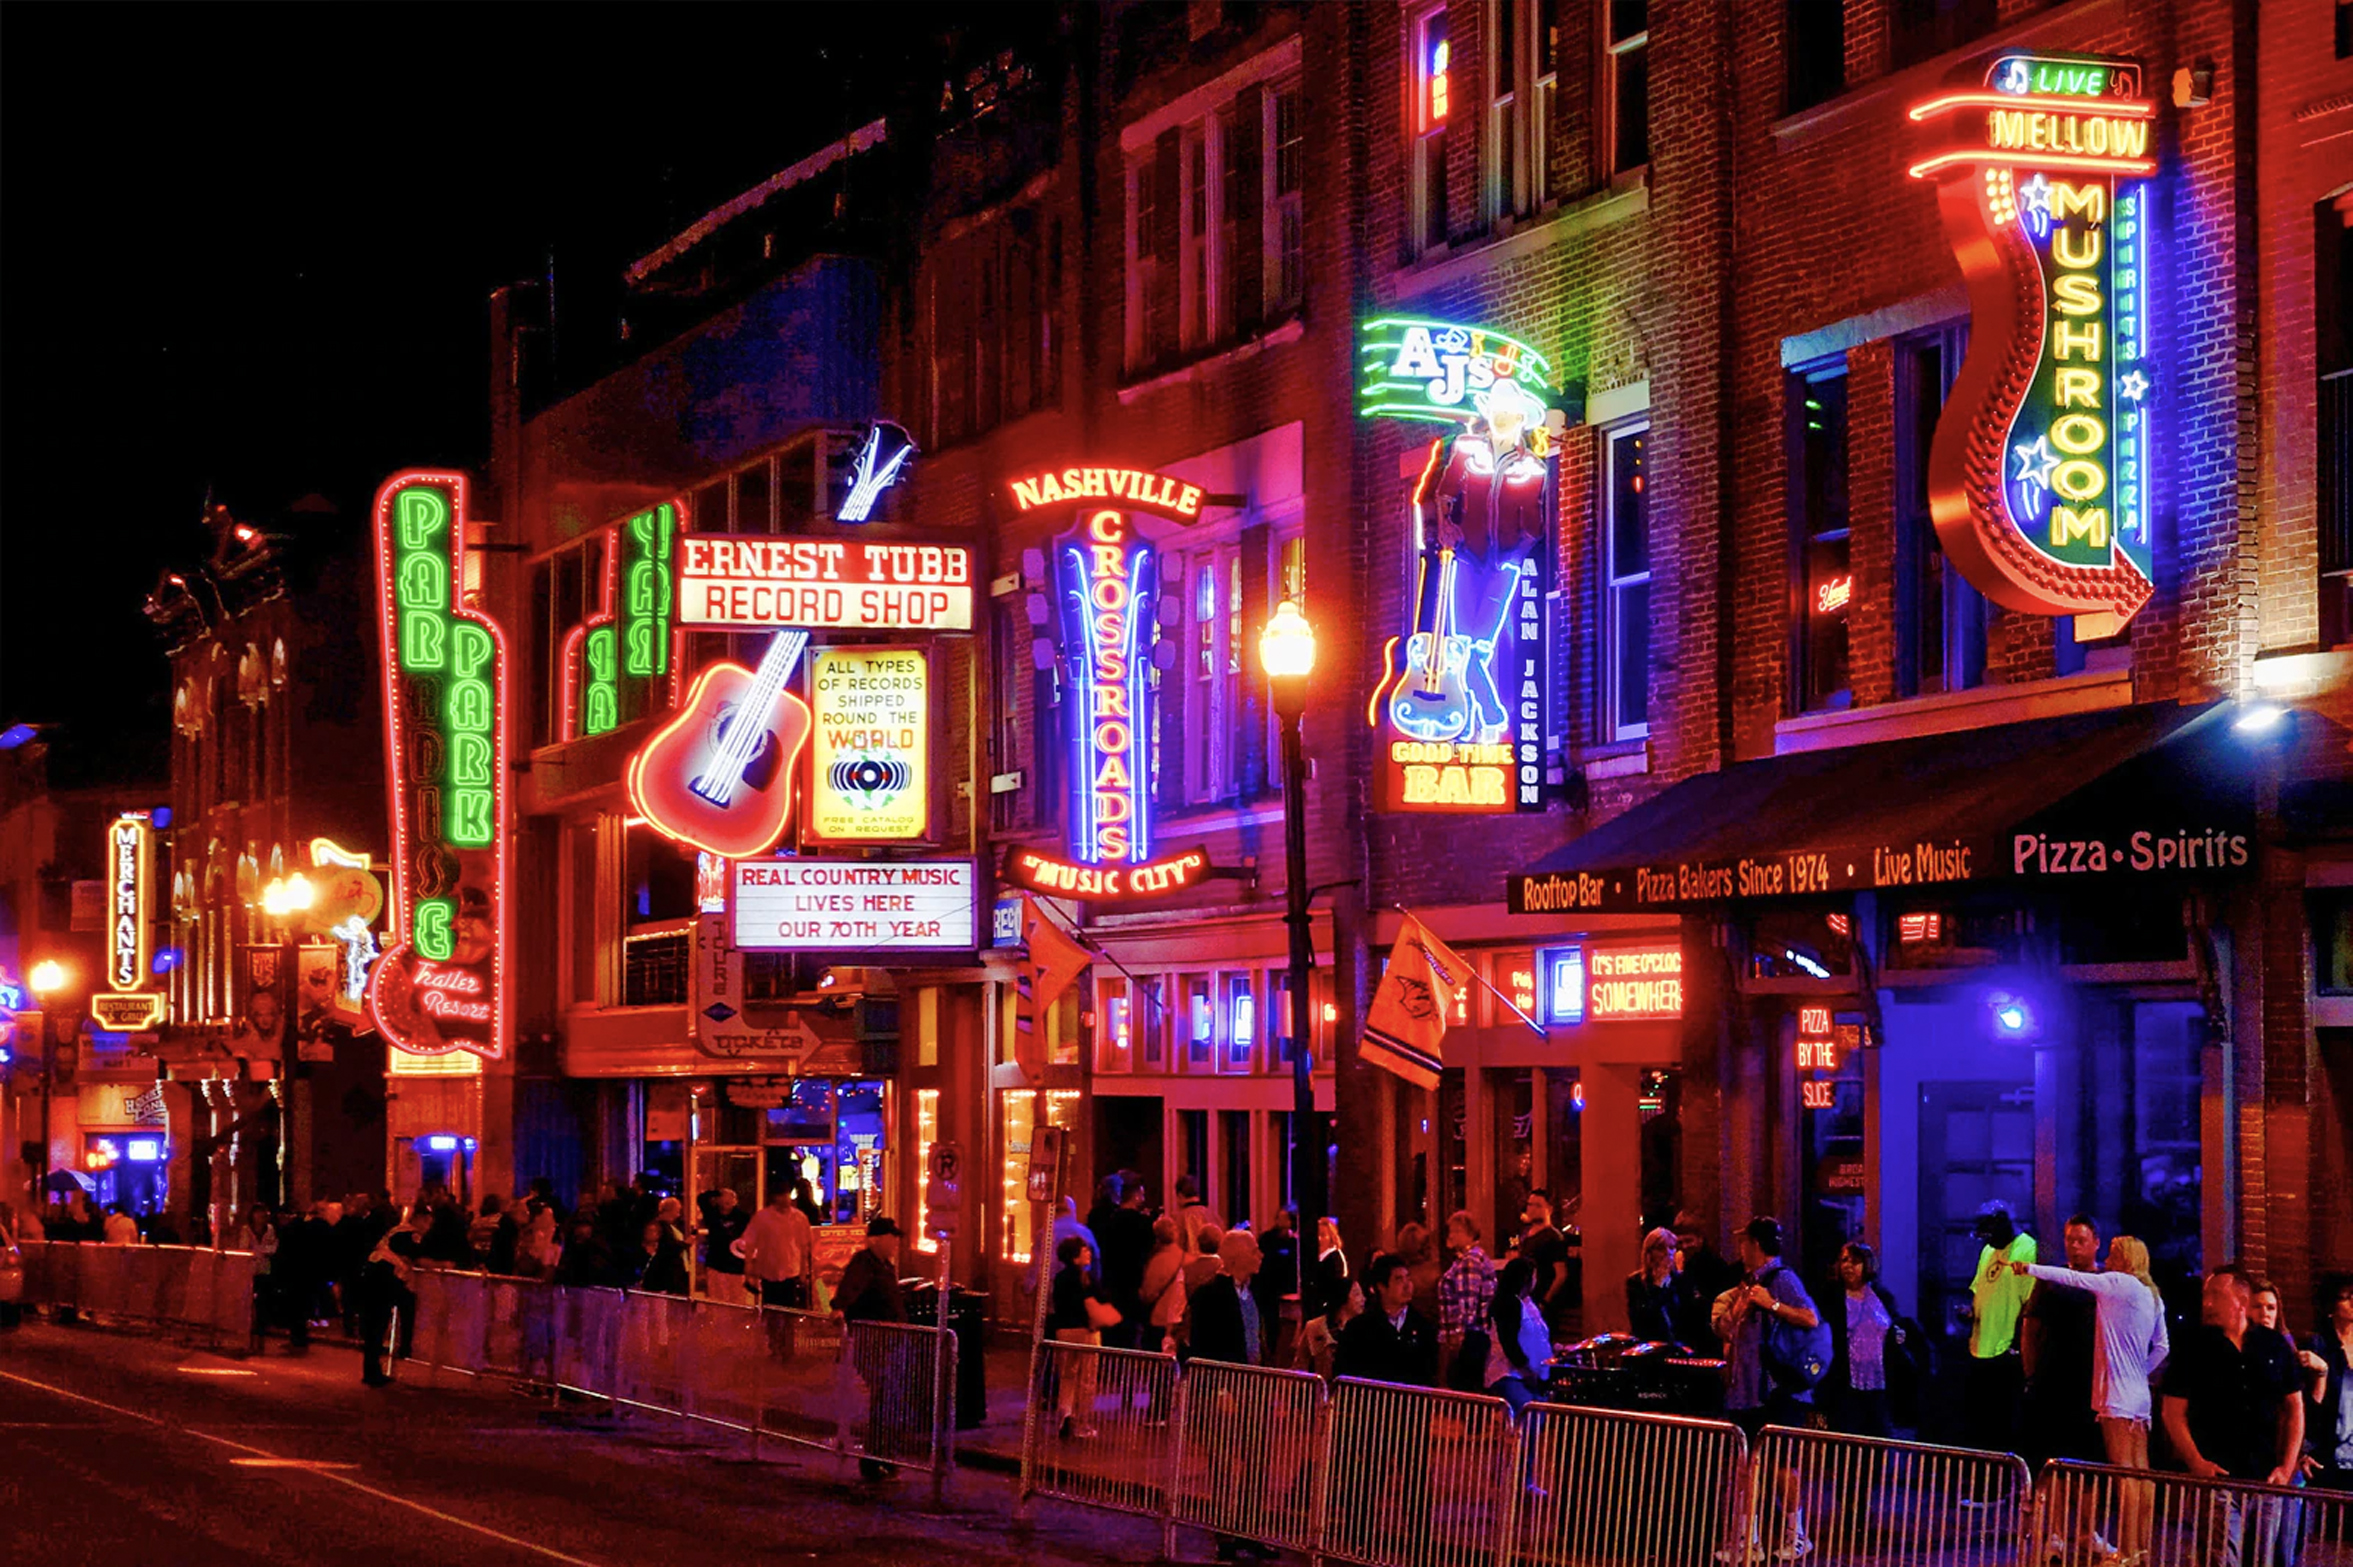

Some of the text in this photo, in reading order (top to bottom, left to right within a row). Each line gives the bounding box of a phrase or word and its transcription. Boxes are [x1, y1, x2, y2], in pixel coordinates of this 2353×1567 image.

[2040, 67, 2103, 96] LIVE
[1987, 110, 2147, 157] MELLOW
[2049, 181, 2107, 547] MUSHROOM
[2116, 197, 2138, 530] SPIRITS PIZZA
[1012, 469, 1201, 516] NASHVILLE
[684, 539, 967, 583] ERNEST TUBB
[706, 586, 948, 624] RECORD SHOP
[827, 660, 915, 674] ALL TYPES
[1521, 558, 1539, 804] ALAN JACKSON
[818, 677, 923, 691] OF RECORDS
[1090, 510, 1131, 861] CROSSROADS
[838, 695, 905, 708] SHIPPED
[823, 711, 917, 725] ROUND THE
[450, 624, 492, 842] PARK
[828, 729, 914, 750] WORLD
[1391, 741, 1515, 765] GOOD TIME
[1403, 766, 1506, 804] BAR
[856, 825, 910, 833] REQUEST
[863, 816, 914, 824] CATALOG
[1874, 840, 1972, 886] Live Music
[2014, 828, 2248, 874] Pizza Spirits
[742, 868, 960, 886] REAL COUNTRY MUSIC
[1524, 872, 1604, 911] Rooftop Bar
[1637, 853, 1829, 903] Pizza Bakers Since 1974
[116, 827, 137, 985] MERCHANTS
[796, 895, 915, 912] LIVES HERE
[779, 921, 941, 938] OUR 70TH YEAR
[1641, 952, 1682, 973] O'CLOC
[99, 1001, 153, 1012] RESTAURANT
[423, 991, 491, 1020] Resort
[1592, 980, 1682, 1015] SOMEWHER
[1802, 1009, 1829, 1033] PIZZA
[713, 1034, 804, 1049] TICKETS
[1798, 1043, 1835, 1067] BY THE
[1803, 1082, 1833, 1107] SLICE
